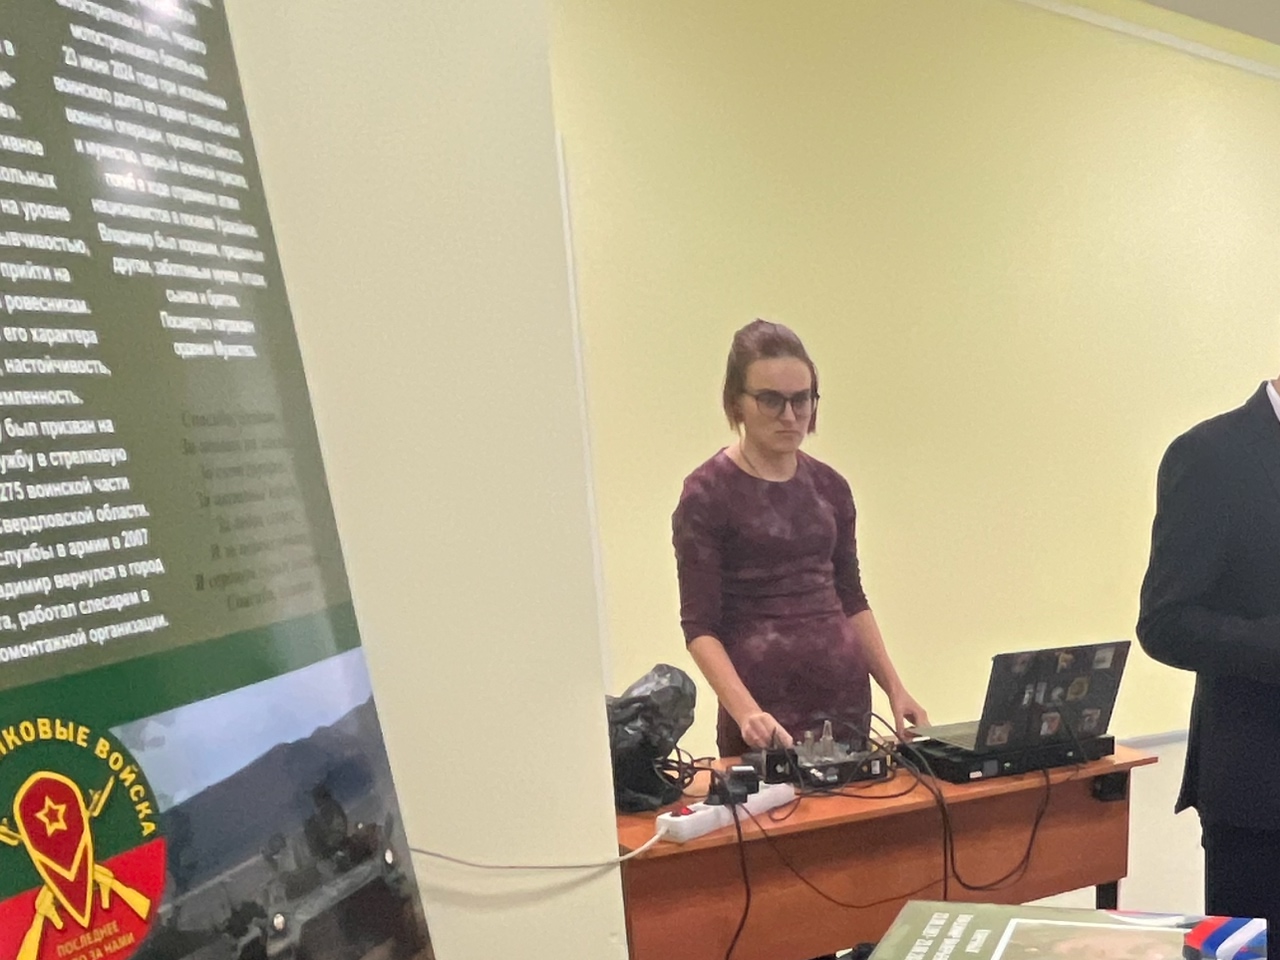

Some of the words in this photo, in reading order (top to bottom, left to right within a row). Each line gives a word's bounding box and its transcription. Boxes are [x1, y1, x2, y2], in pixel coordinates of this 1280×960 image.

[0, 198, 19, 215] на
[20, 201, 71, 222] уровне
[0, 260, 53, 283] прийти
[54, 267, 71, 282] на
[3, 326, 28, 342] его
[30, 327, 99, 348] характера
[4, 354, 112, 377] настойчивость,
[4, 417, 39, 437] был
[40, 419, 97, 440] призван
[97, 419, 115, 433] на
[0, 448, 34, 475] ужбу
[36, 452, 48, 467] в
[49, 447, 127, 470] стрелковую
[26, 475, 93, 500] воинской
[93, 476, 131, 493] части
[0, 506, 95, 536] вердловской
[96, 503, 150, 523] области.
[56, 543, 67, 558] в
[68, 538, 111, 559] армии
[111, 535, 122, 550] в
[121, 528, 148, 549] 2007
[53, 566, 117, 591] вернулся
[118, 564, 128, 579] в
[128, 558, 165, 579] город
[18, 603, 78, 632] работал
[79, 591, 141, 615] слесарем
[140, 589, 150, 603] в
[89, 614, 170, 647] организации.
[94, 736, 156, 837] ВОЙСКА
[57, 919, 119, 958] ПОСЛЕДНЕЕ
[104, 931, 136, 954] НАМИ
